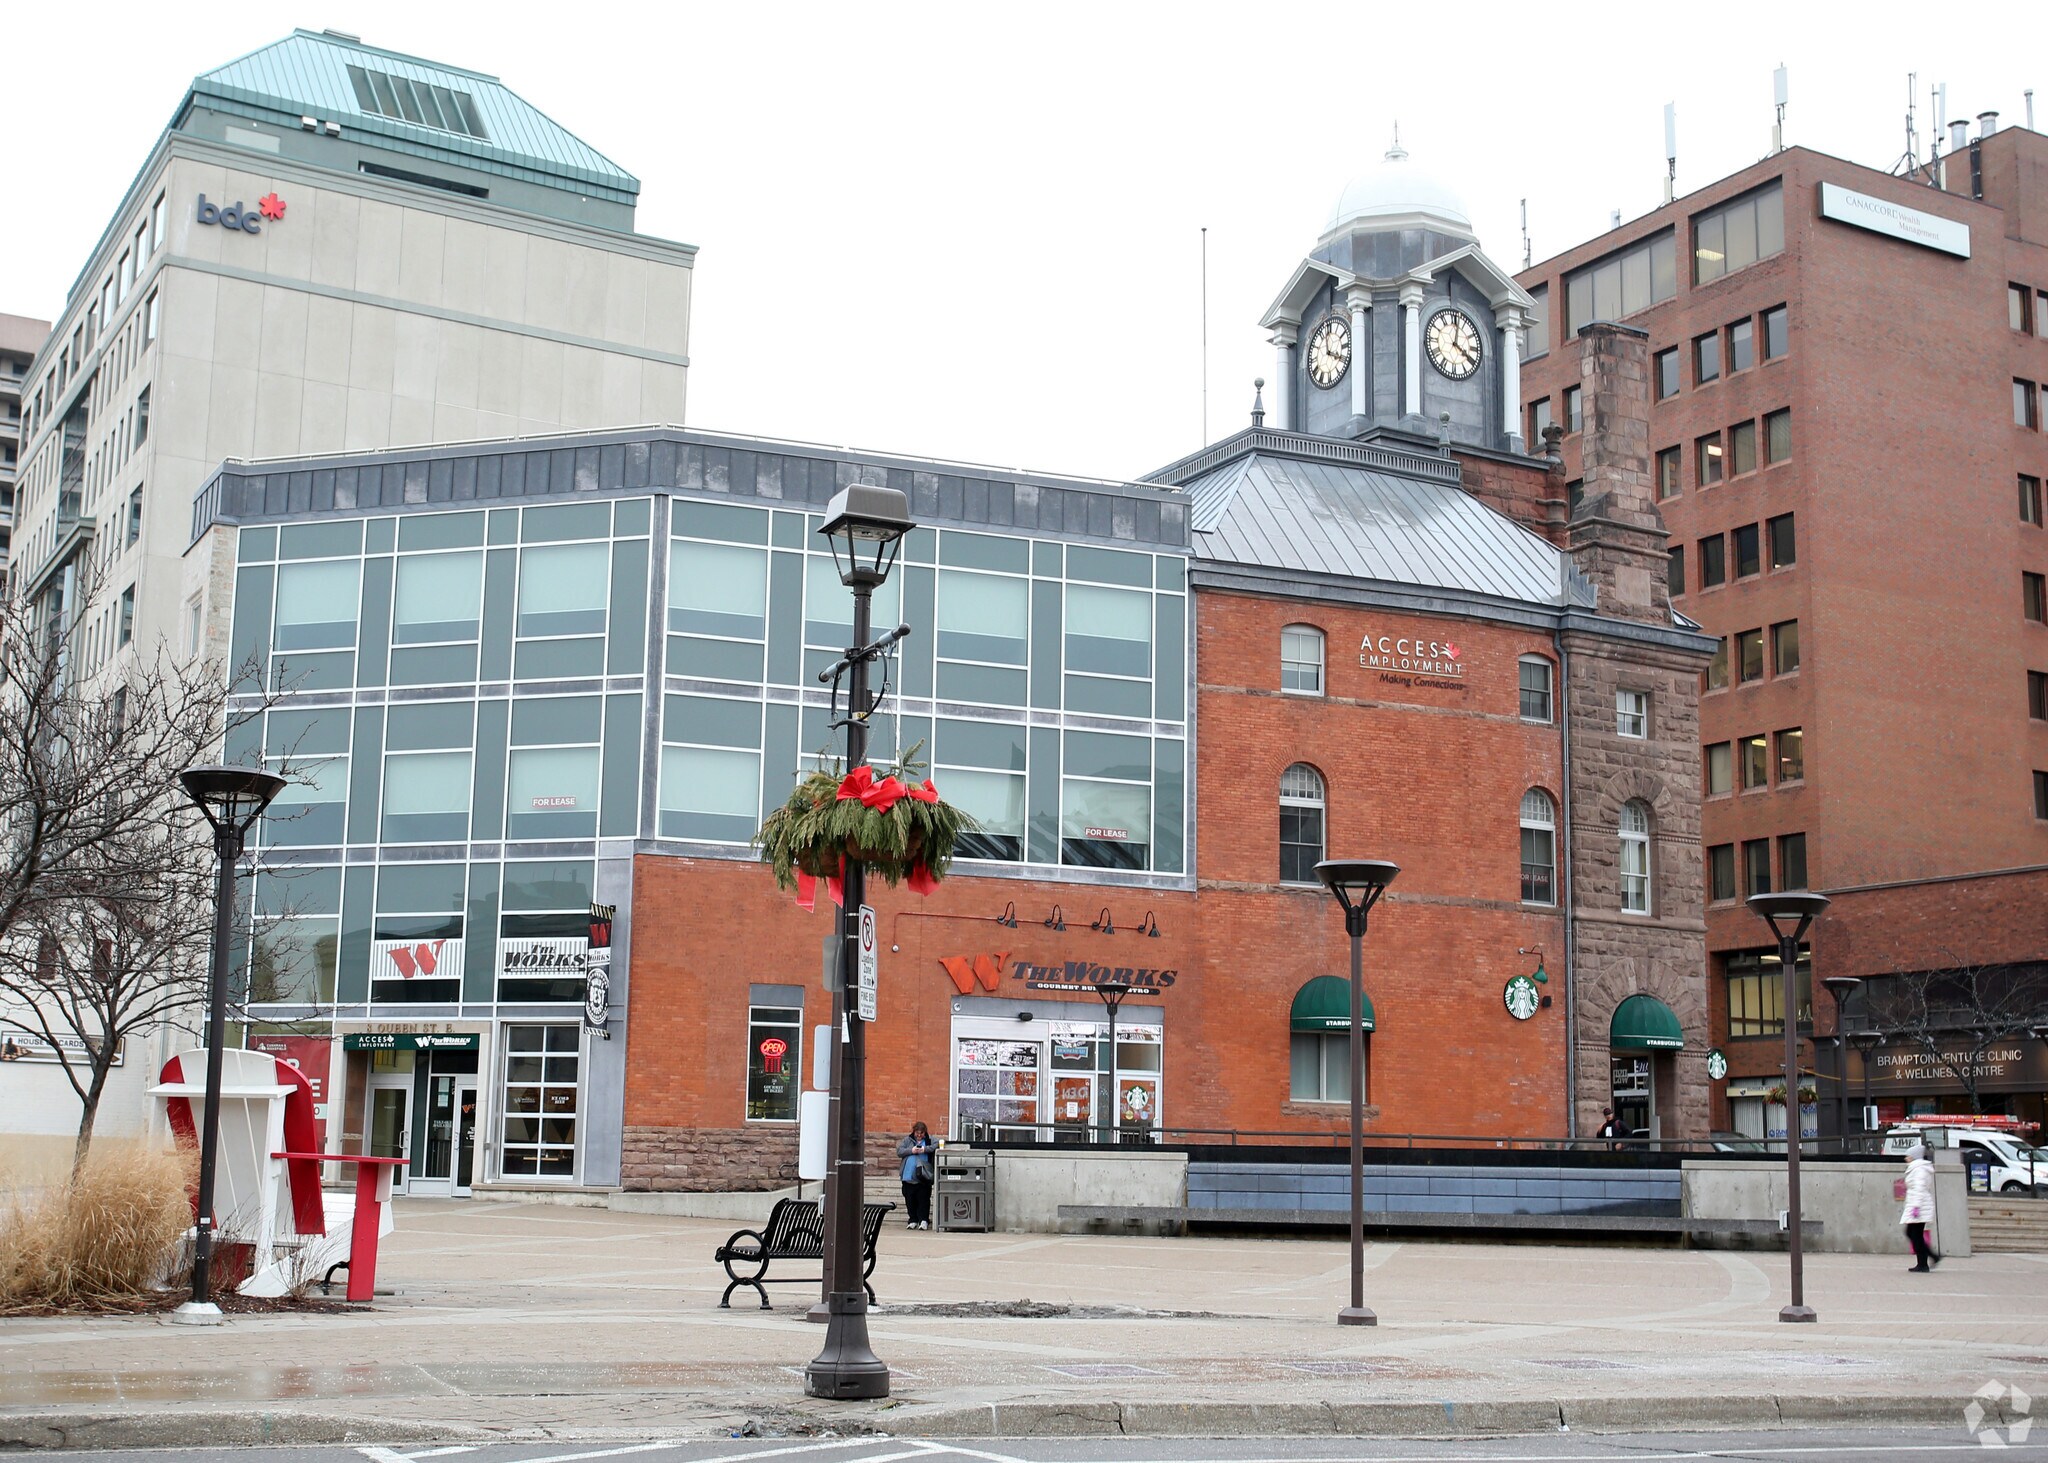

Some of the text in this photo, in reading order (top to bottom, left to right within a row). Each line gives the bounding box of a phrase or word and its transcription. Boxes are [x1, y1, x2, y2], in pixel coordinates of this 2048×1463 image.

[197, 193, 261, 234] bdc
[1898, 211, 1921, 226] Wealth
[1898, 222, 1939, 241] Management
[1360, 653, 1462, 675] EMPLOYMENT
[1379, 673, 1464, 690] Making Connections
[532, 797, 576, 806] FOR LEASE
[1085, 828, 1127, 838] FOR LEASE
[590, 923, 611, 947] W
[386, 938, 447, 979] W
[505, 952, 587, 967] WORKS
[938, 950, 1012, 994] W
[1037, 982, 1080, 991] GOURMET
[377, 1023, 417, 1034] QUEEN
[423, 1023, 440, 1034] ST.
[17, 1037, 44, 1046] HOUSE
[59, 1039, 85, 1048] CARDS
[763, 1042, 784, 1053] OPEN
[1877, 1053, 1936, 1067] BRAMPTON
[1987, 1049, 2022, 1062] CLINIC
[1895, 1071, 1903, 1080] &
